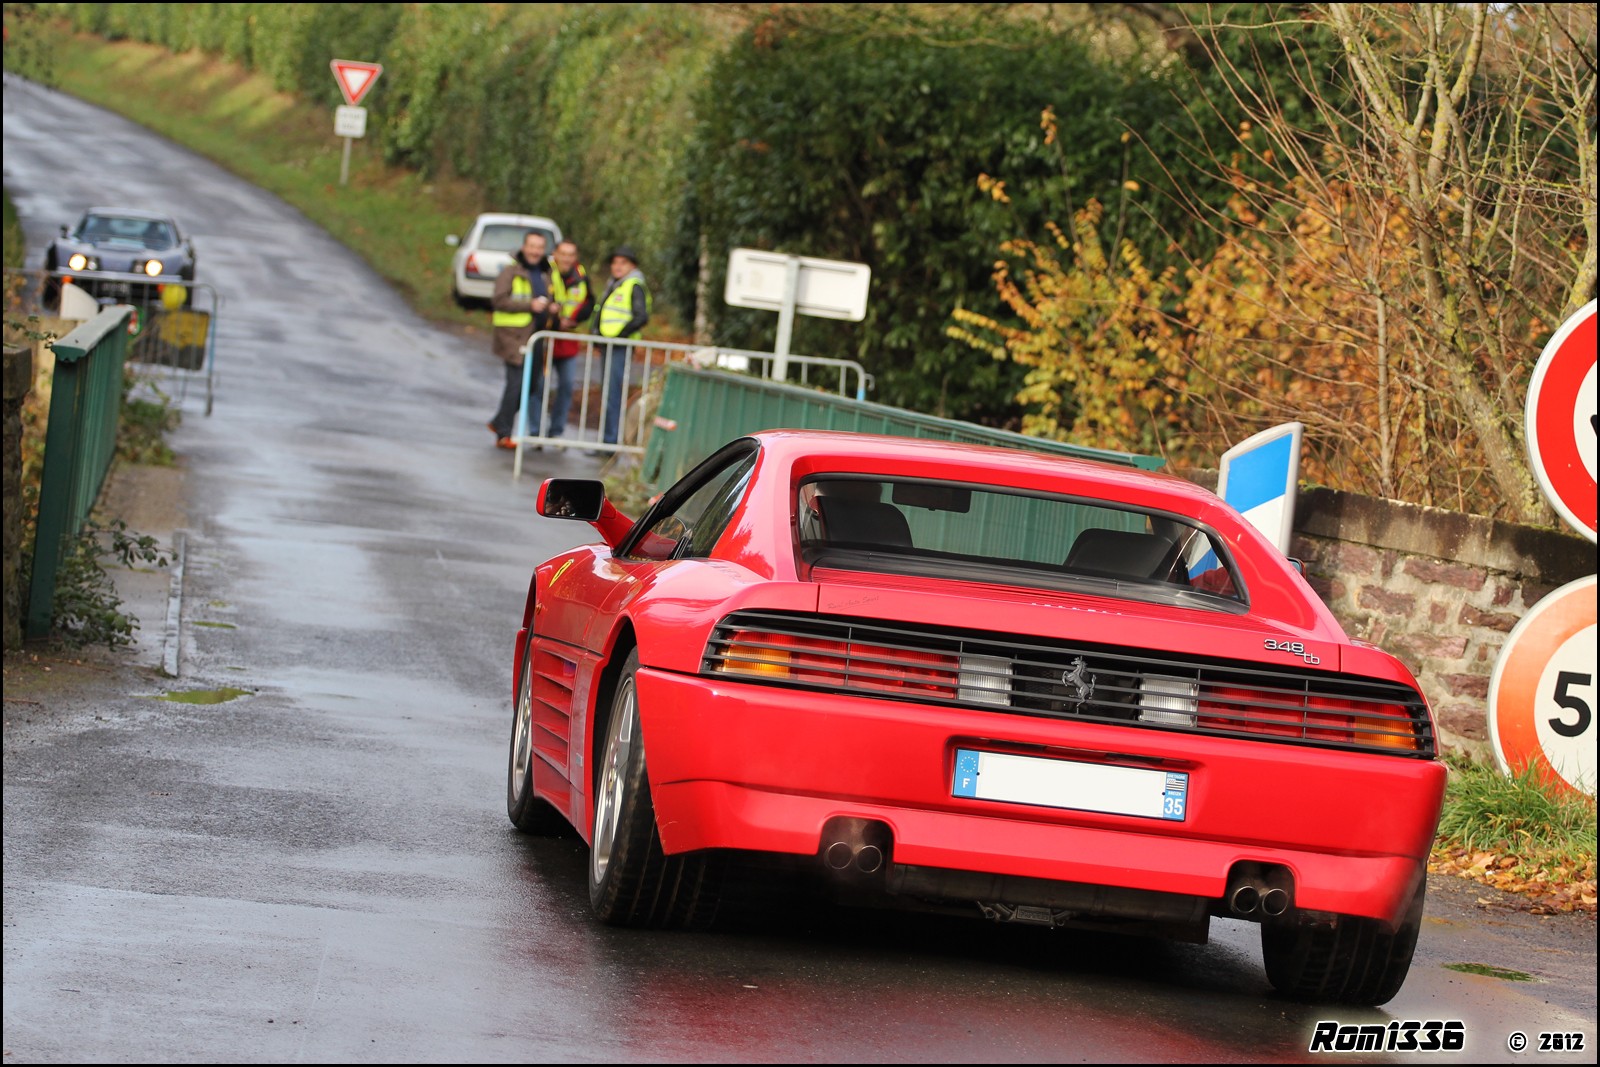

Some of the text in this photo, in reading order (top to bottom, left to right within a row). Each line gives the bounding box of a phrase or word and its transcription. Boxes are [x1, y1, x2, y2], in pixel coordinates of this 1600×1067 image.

[1264, 639, 1321, 666] 348 tb
[962, 778, 970, 788] F
[1165, 798, 1182, 815] 35
